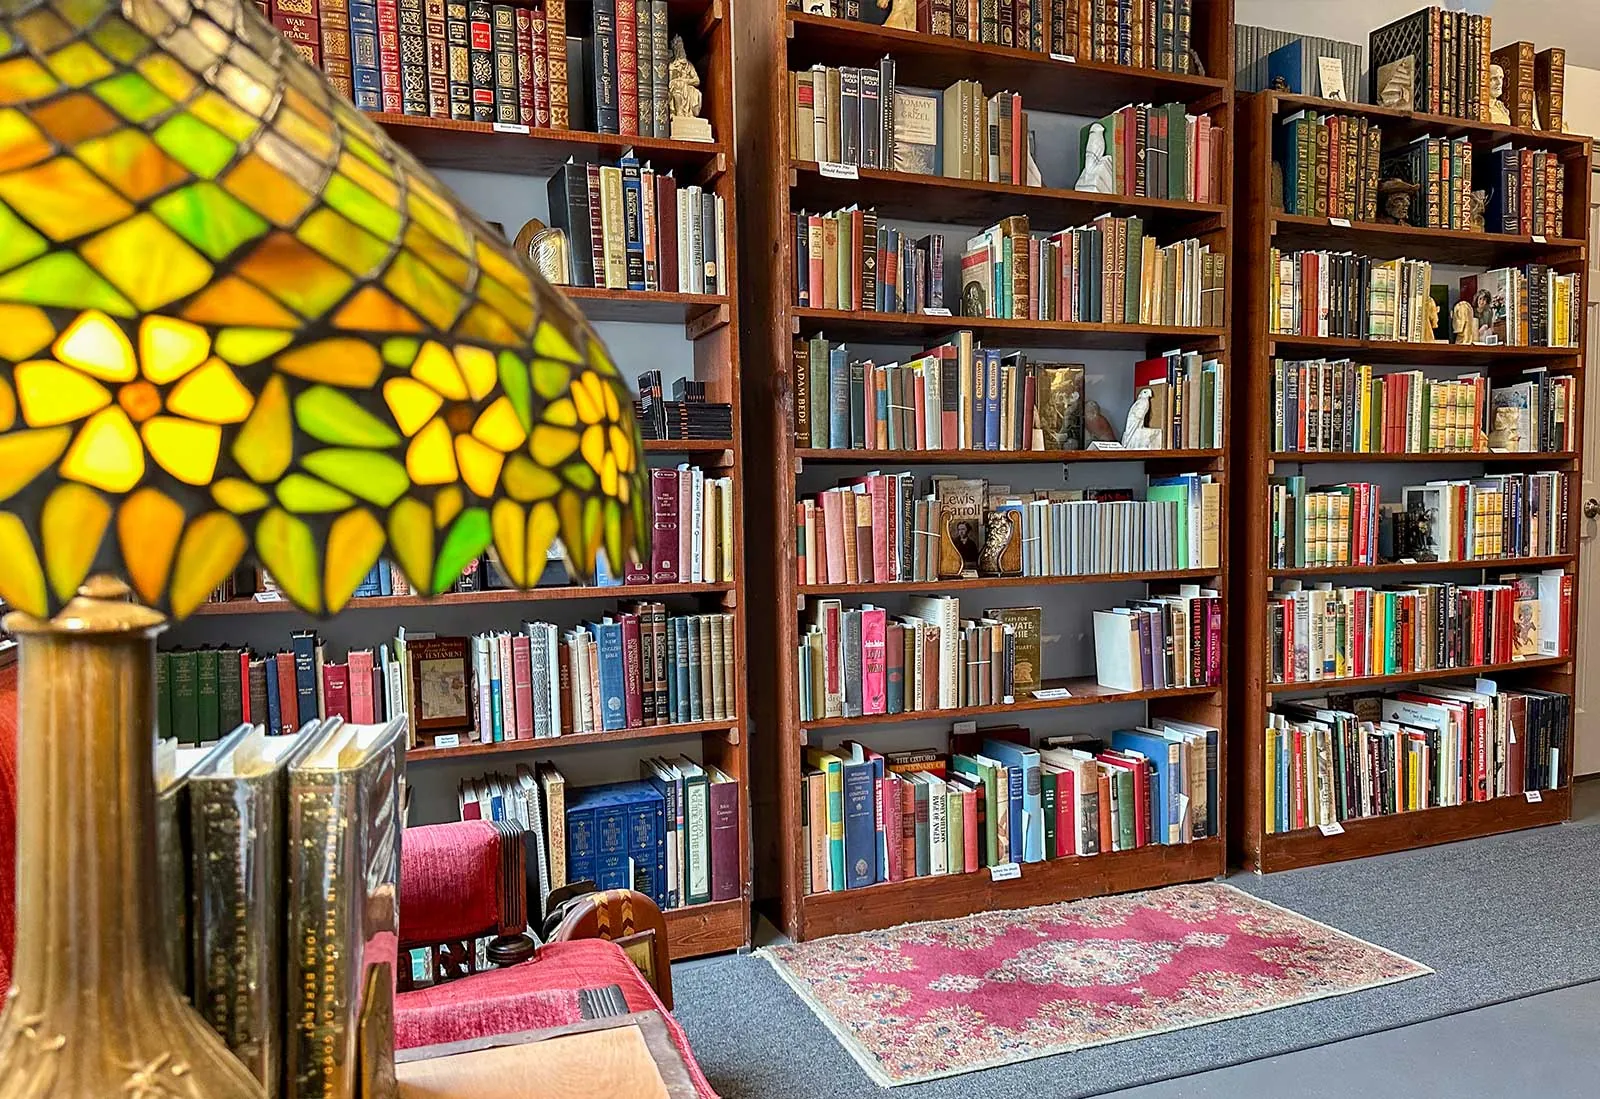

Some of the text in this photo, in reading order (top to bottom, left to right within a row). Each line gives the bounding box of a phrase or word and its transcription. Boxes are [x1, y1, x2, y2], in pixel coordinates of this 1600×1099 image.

[284, 30, 310, 40] PEACE
[900, 100, 932, 109] TOMMY
[901, 112, 929, 122] GRIZEL
[943, 494, 975, 505] Lewis
[933, 812, 939, 821] OF
[326, 808, 336, 880] MIDNIGHT
[326, 887, 336, 901] IN
[236, 902, 245, 920] IN
[326, 910, 336, 936] THE
[235, 926, 247, 954] THE
[325, 944, 335, 1002] GARDEN
[235, 960, 247, 1024] GARDEN
[305, 928, 316, 1039] JOHN BERENDT
[324, 1011, 333, 1026] OF
[323, 1035, 333, 1074] GOOD
